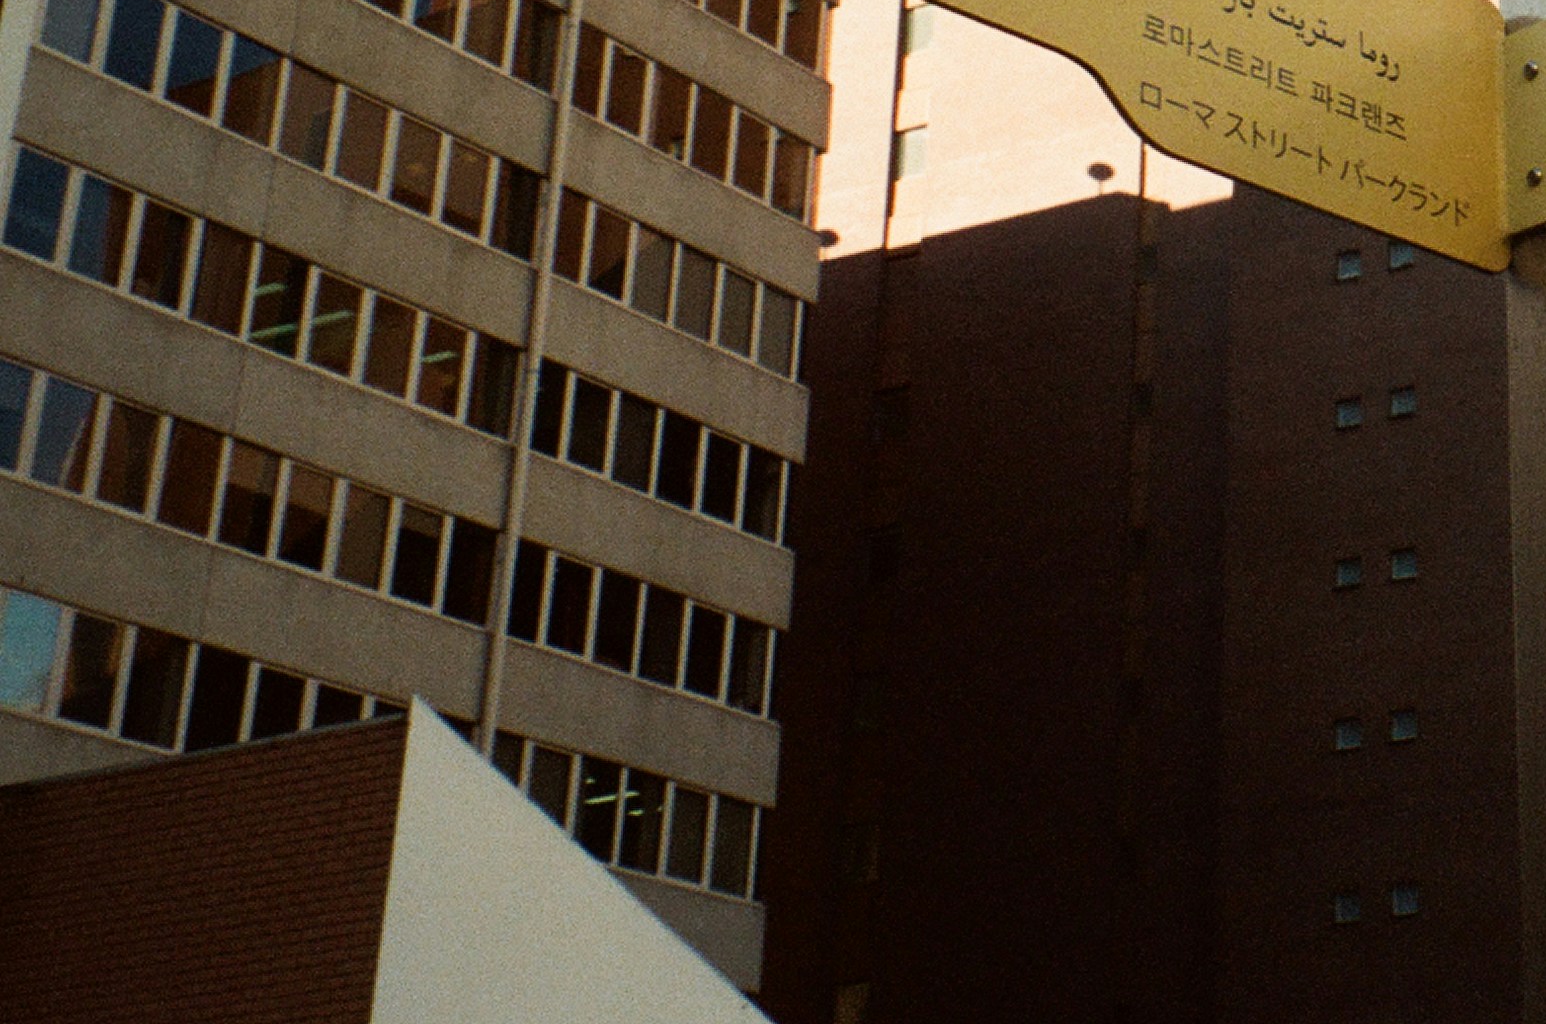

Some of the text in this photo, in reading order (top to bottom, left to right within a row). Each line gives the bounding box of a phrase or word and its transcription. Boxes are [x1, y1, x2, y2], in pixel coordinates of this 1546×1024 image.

[1268, 5, 1346, 48] ستريت
[1143, 14, 1408, 140] 로마스트리트 파크랜즈
[1360, 31, 1400, 81] روما
